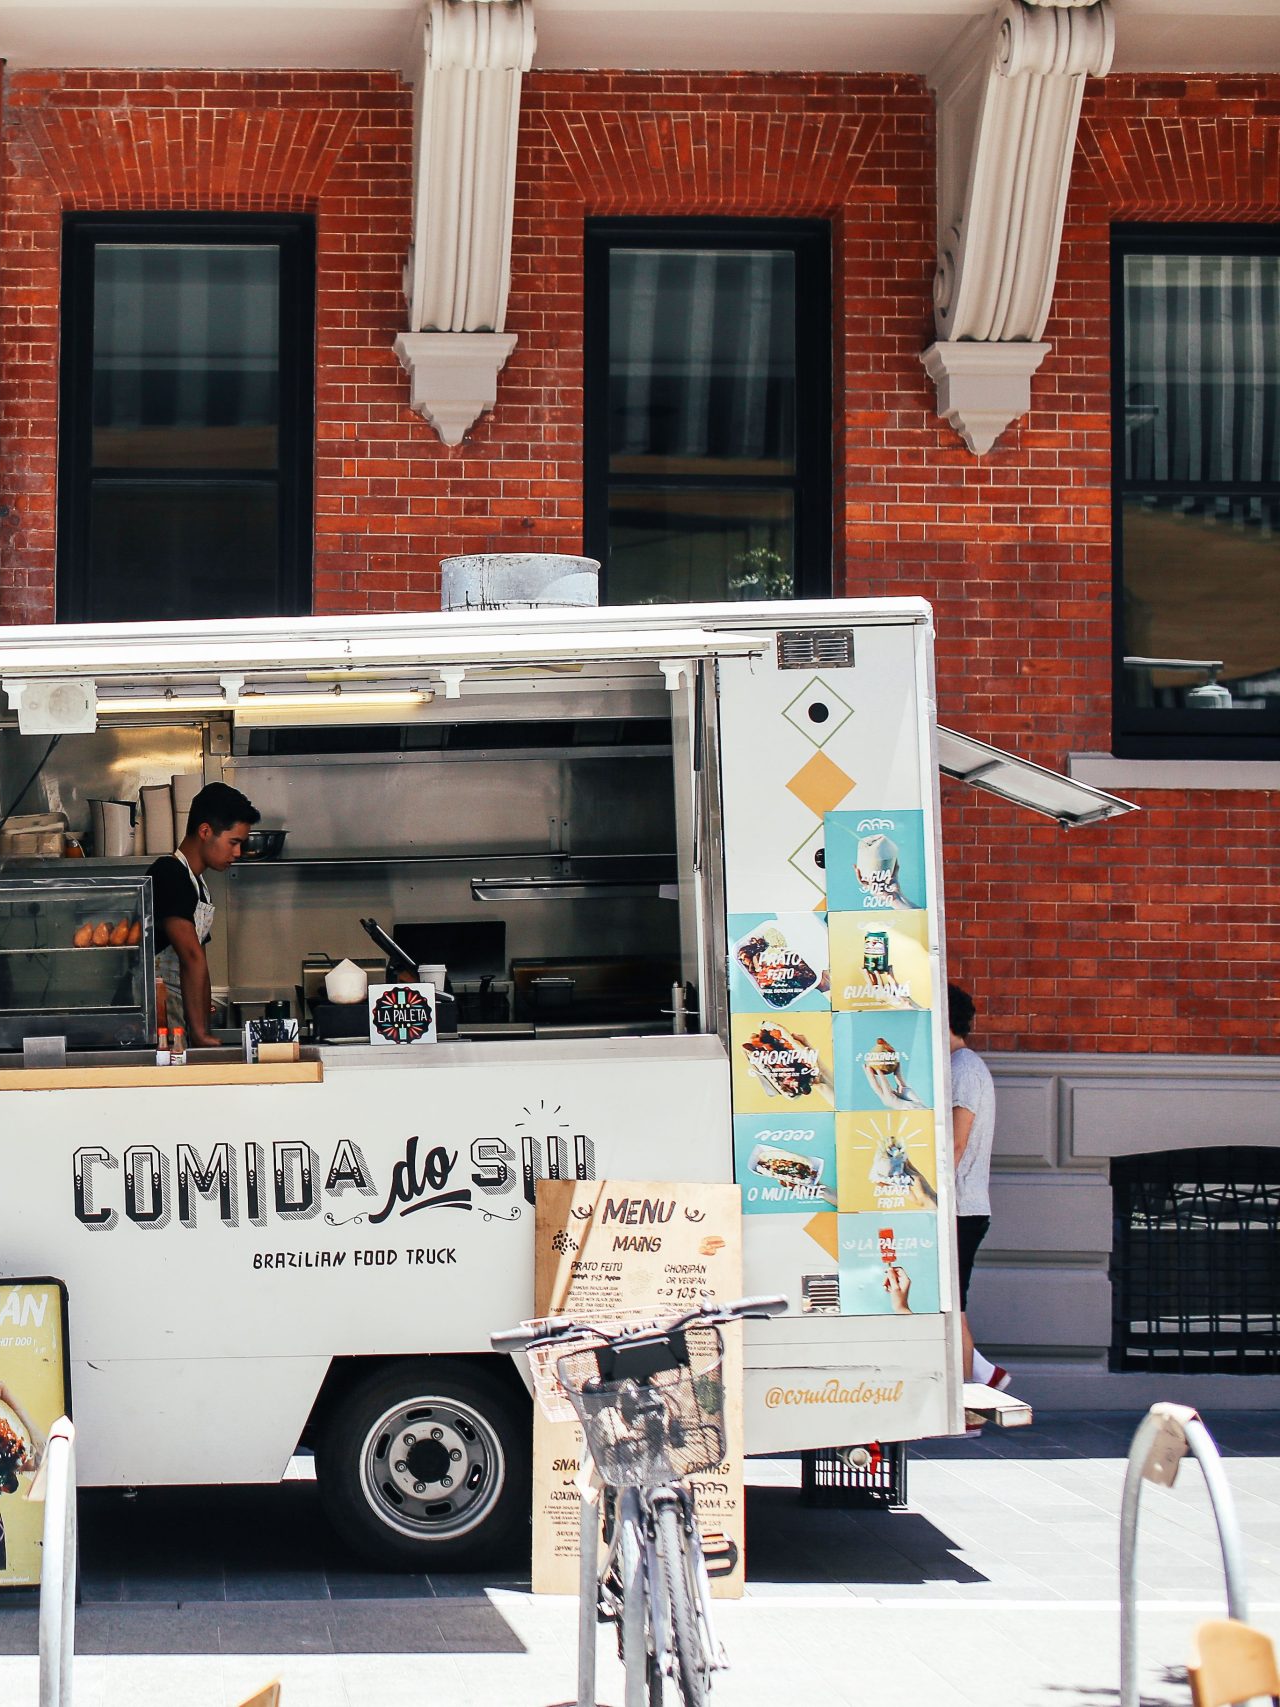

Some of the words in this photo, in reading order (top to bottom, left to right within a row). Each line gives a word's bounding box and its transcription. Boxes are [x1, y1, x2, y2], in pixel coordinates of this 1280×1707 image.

[378, 1011, 391, 1023] LA
[393, 1009, 428, 1022] PALETA
[72, 1138, 380, 1233] COMIDA
[368, 1135, 459, 1225] do
[747, 1186, 759, 1202] O
[761, 1184, 827, 1202] MUTANTE
[601, 1197, 677, 1226] MENU
[612, 1235, 663, 1253] MAiNS
[857, 1237, 874, 1251] LA
[876, 1236, 918, 1250] PALETA
[353, 1249, 399, 1268] FOOD
[405, 1246, 458, 1265] TRUCK
[570, 1261, 599, 1272] PRATO
[676, 1286, 698, 1300] 10$
